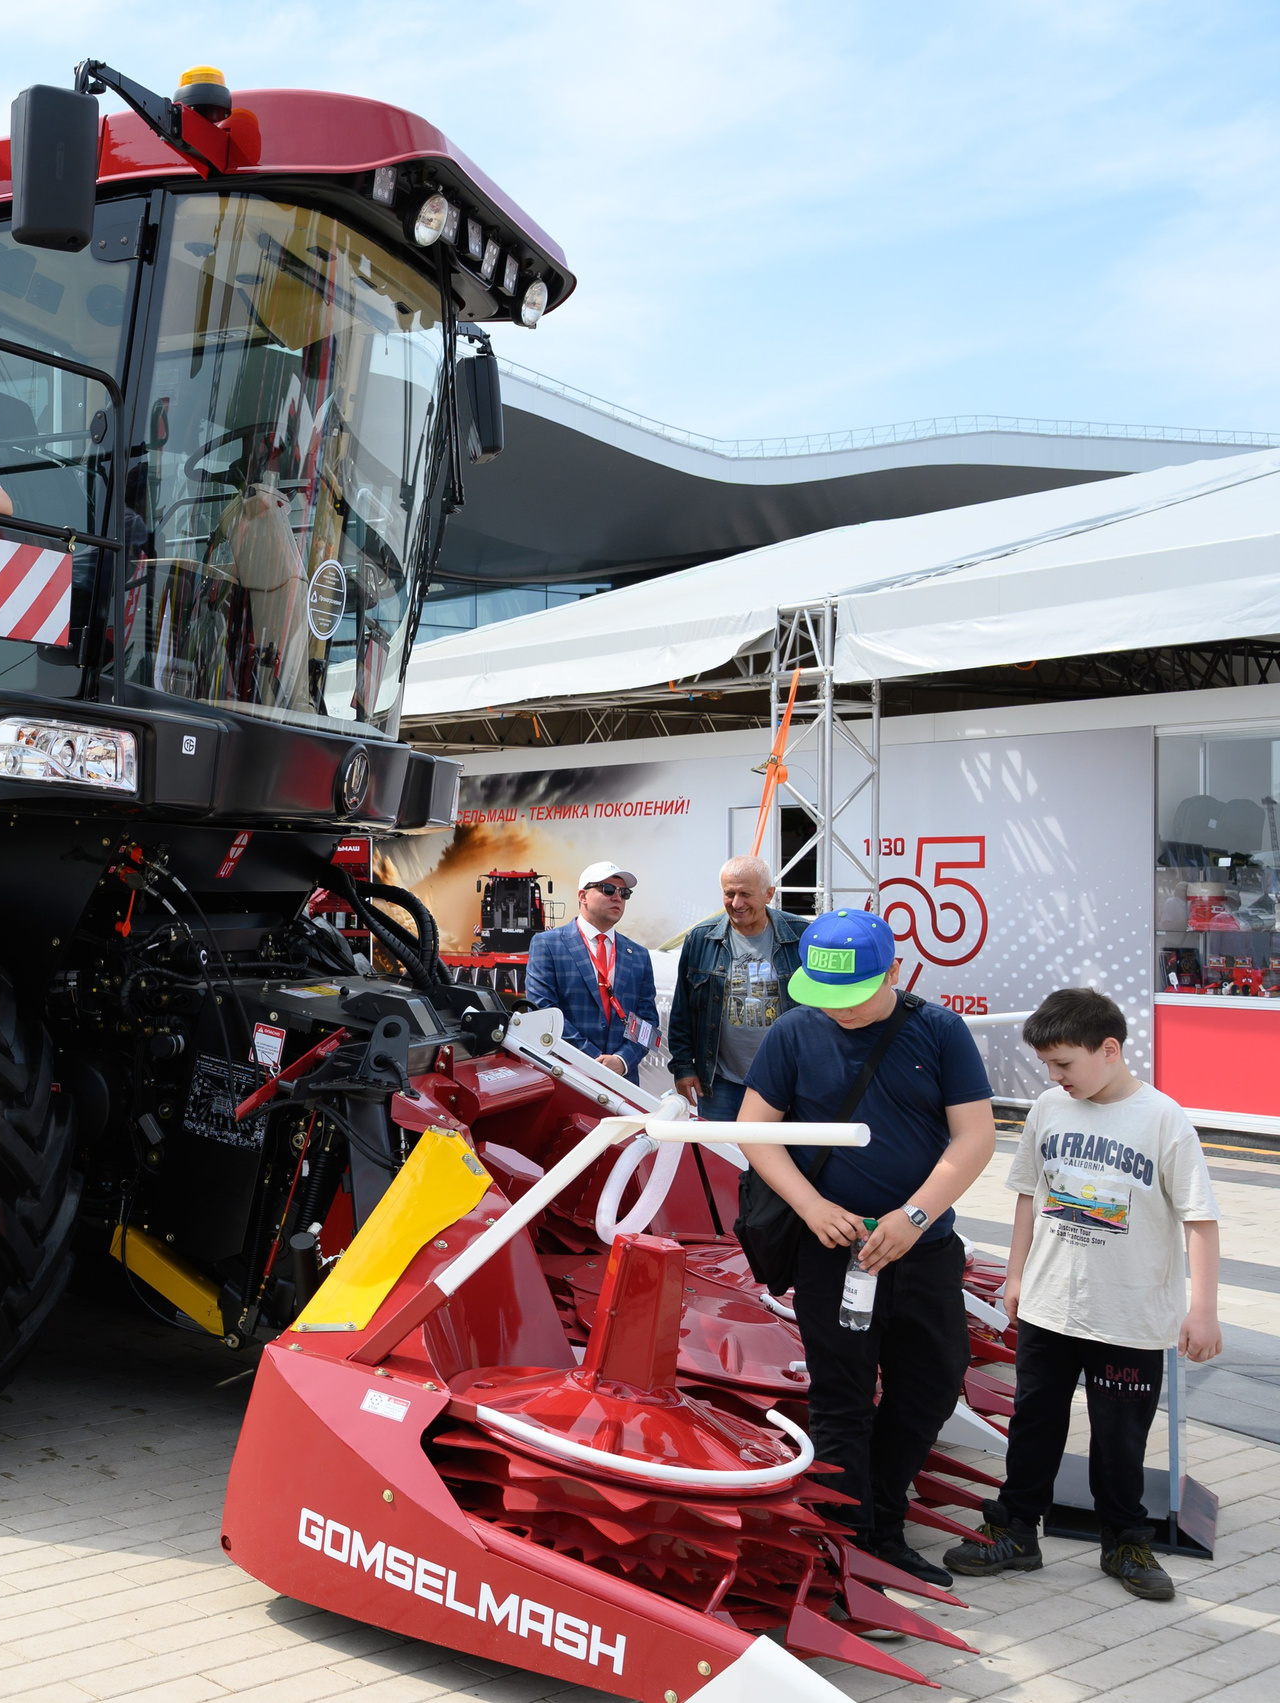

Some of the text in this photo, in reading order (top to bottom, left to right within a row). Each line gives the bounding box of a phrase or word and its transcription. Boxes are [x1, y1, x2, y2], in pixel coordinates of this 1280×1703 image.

[529, 804, 590, 821] ТЕХНИКА
[594, 796, 691, 819] ПОКОЛЕНИЙ!
[810, 949, 850, 970] OBEY
[940, 994, 988, 1016] 2025
[1061, 1132, 1154, 1187] FRANCISCO
[1063, 1157, 1105, 1173] CALIFORNIA
[298, 1507, 626, 1676] GOMSELMASH
